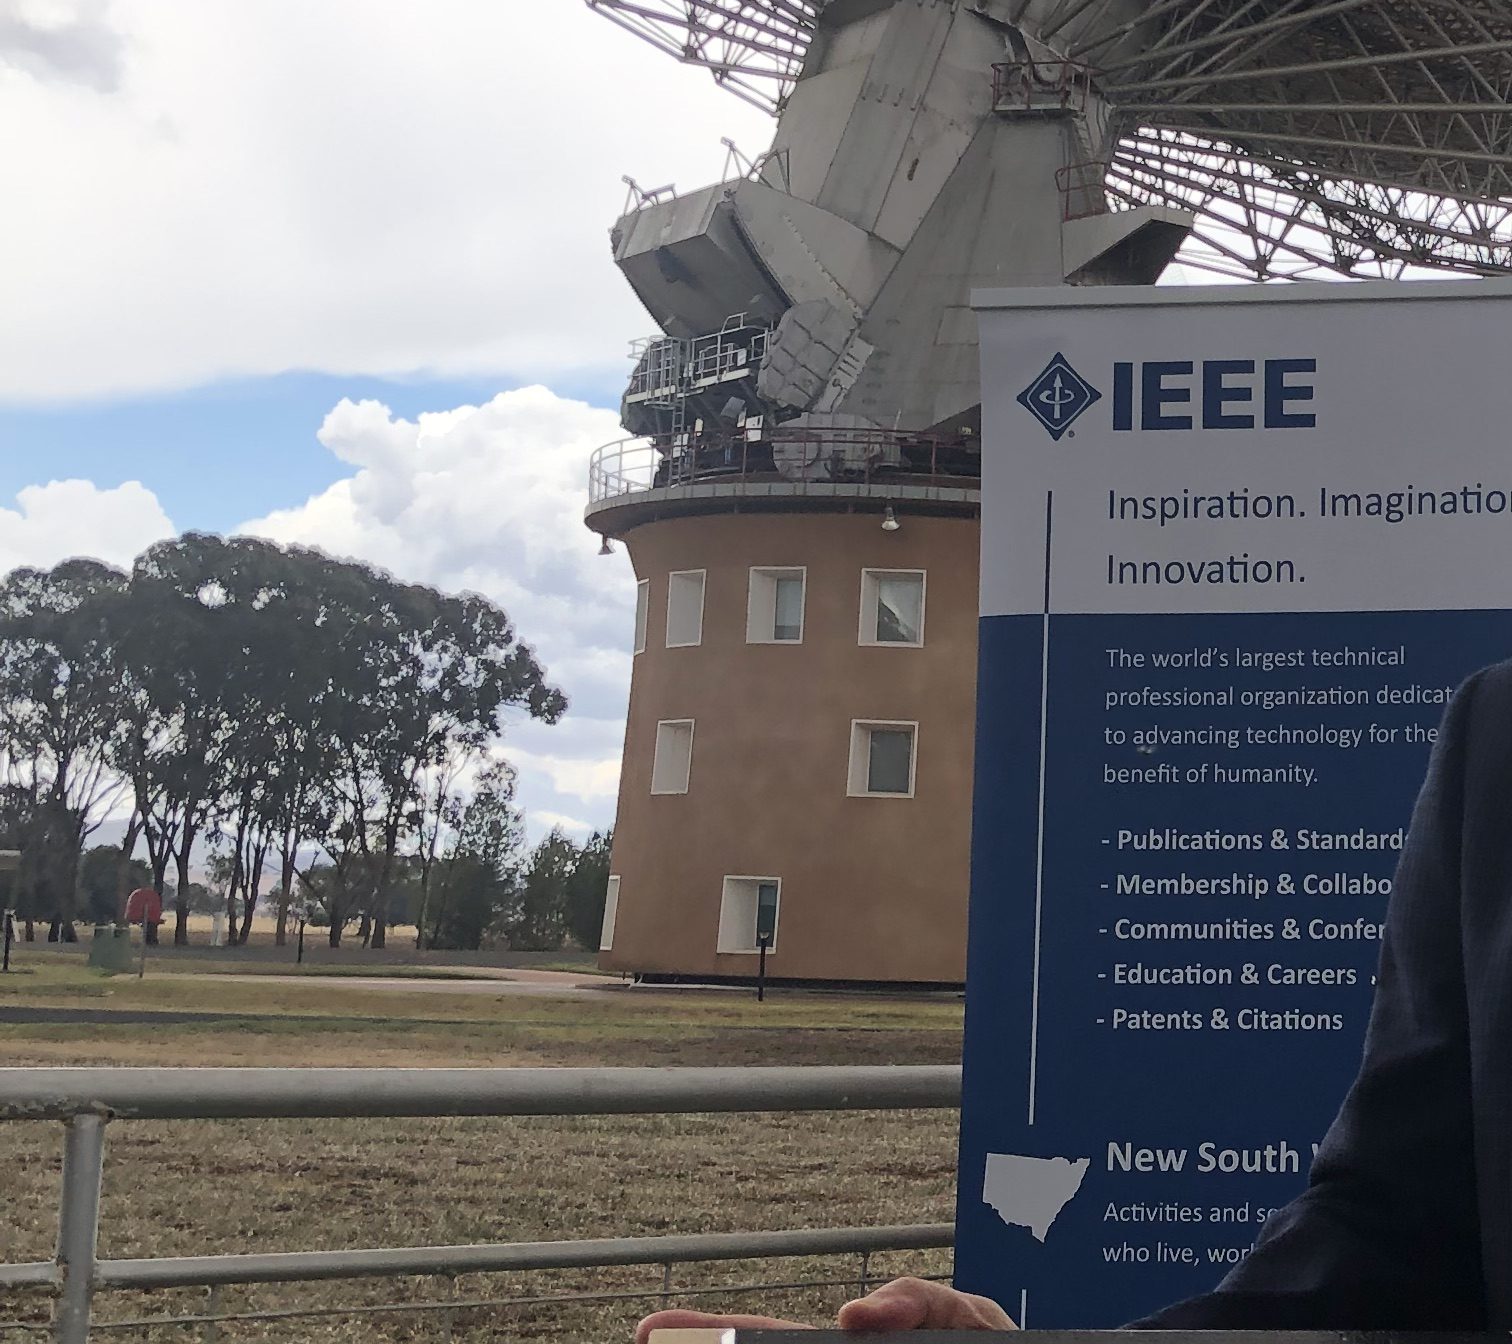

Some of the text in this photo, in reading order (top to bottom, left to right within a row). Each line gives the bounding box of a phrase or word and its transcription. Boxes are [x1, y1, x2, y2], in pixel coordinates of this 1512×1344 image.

[1113, 359, 1316, 430] IEEE
[1110, 488, 1305, 526] Inspiration.
[1109, 553, 1304, 584] Innovation.
[1106, 649, 1144, 667] The
[1237, 648, 1304, 671] largest
[1312, 646, 1404, 666] technical
[1106, 685, 1456, 710] professional organization dedicat
[1104, 723, 1440, 749] to advancing technology for the
[1104, 764, 1317, 788] benefit of humanity.
[1119, 829, 1262, 850] Publications
[1271, 829, 1289, 849] &
[1297, 828, 1409, 849] Standard
[1117, 873, 1268, 899] Membership
[1277, 874, 1295, 894] &
[1115, 919, 1273, 939] Communities
[1282, 919, 1300, 939] &
[1115, 963, 1231, 984] Education
[1241, 963, 1259, 984] &
[1268, 964, 1356, 984] Careers
[1113, 1009, 1202, 1029] Patents
[1211, 1009, 1229, 1029] &
[1238, 1009, 1342, 1029] Citations
[1108, 1142, 1187, 1171] New
[1198, 1141, 1298, 1172] South
[1104, 1202, 1202, 1222] Activities
[1210, 1202, 1248, 1222] and
[1103, 1242, 1149, 1262] who
[1158, 1242, 1199, 1266] live,
